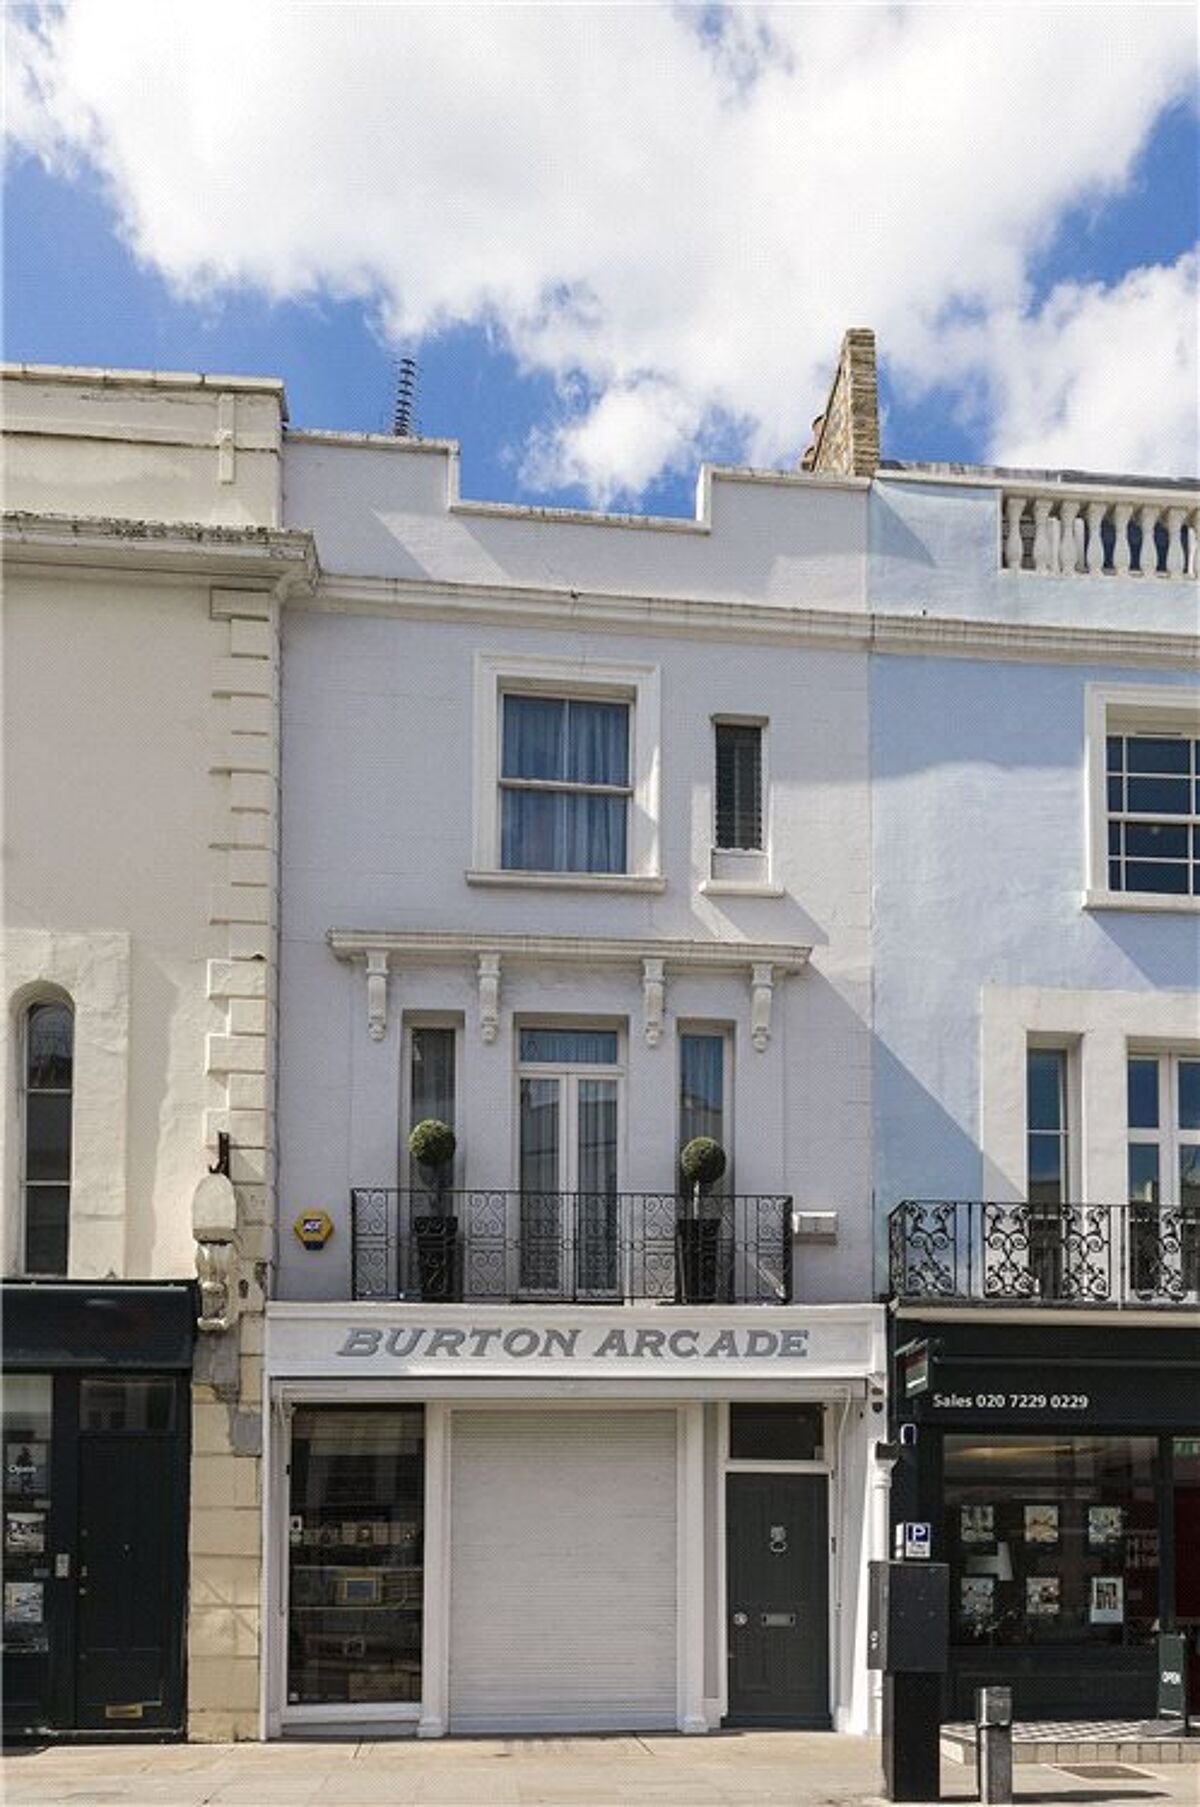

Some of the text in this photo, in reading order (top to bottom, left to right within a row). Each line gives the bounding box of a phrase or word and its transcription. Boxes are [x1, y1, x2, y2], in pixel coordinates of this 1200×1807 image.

[337, 1327, 809, 1357] BURTON ARCADE
[933, 1394, 1088, 1408] Sales 020 7229 0229
[913, 1524, 926, 1540] P
